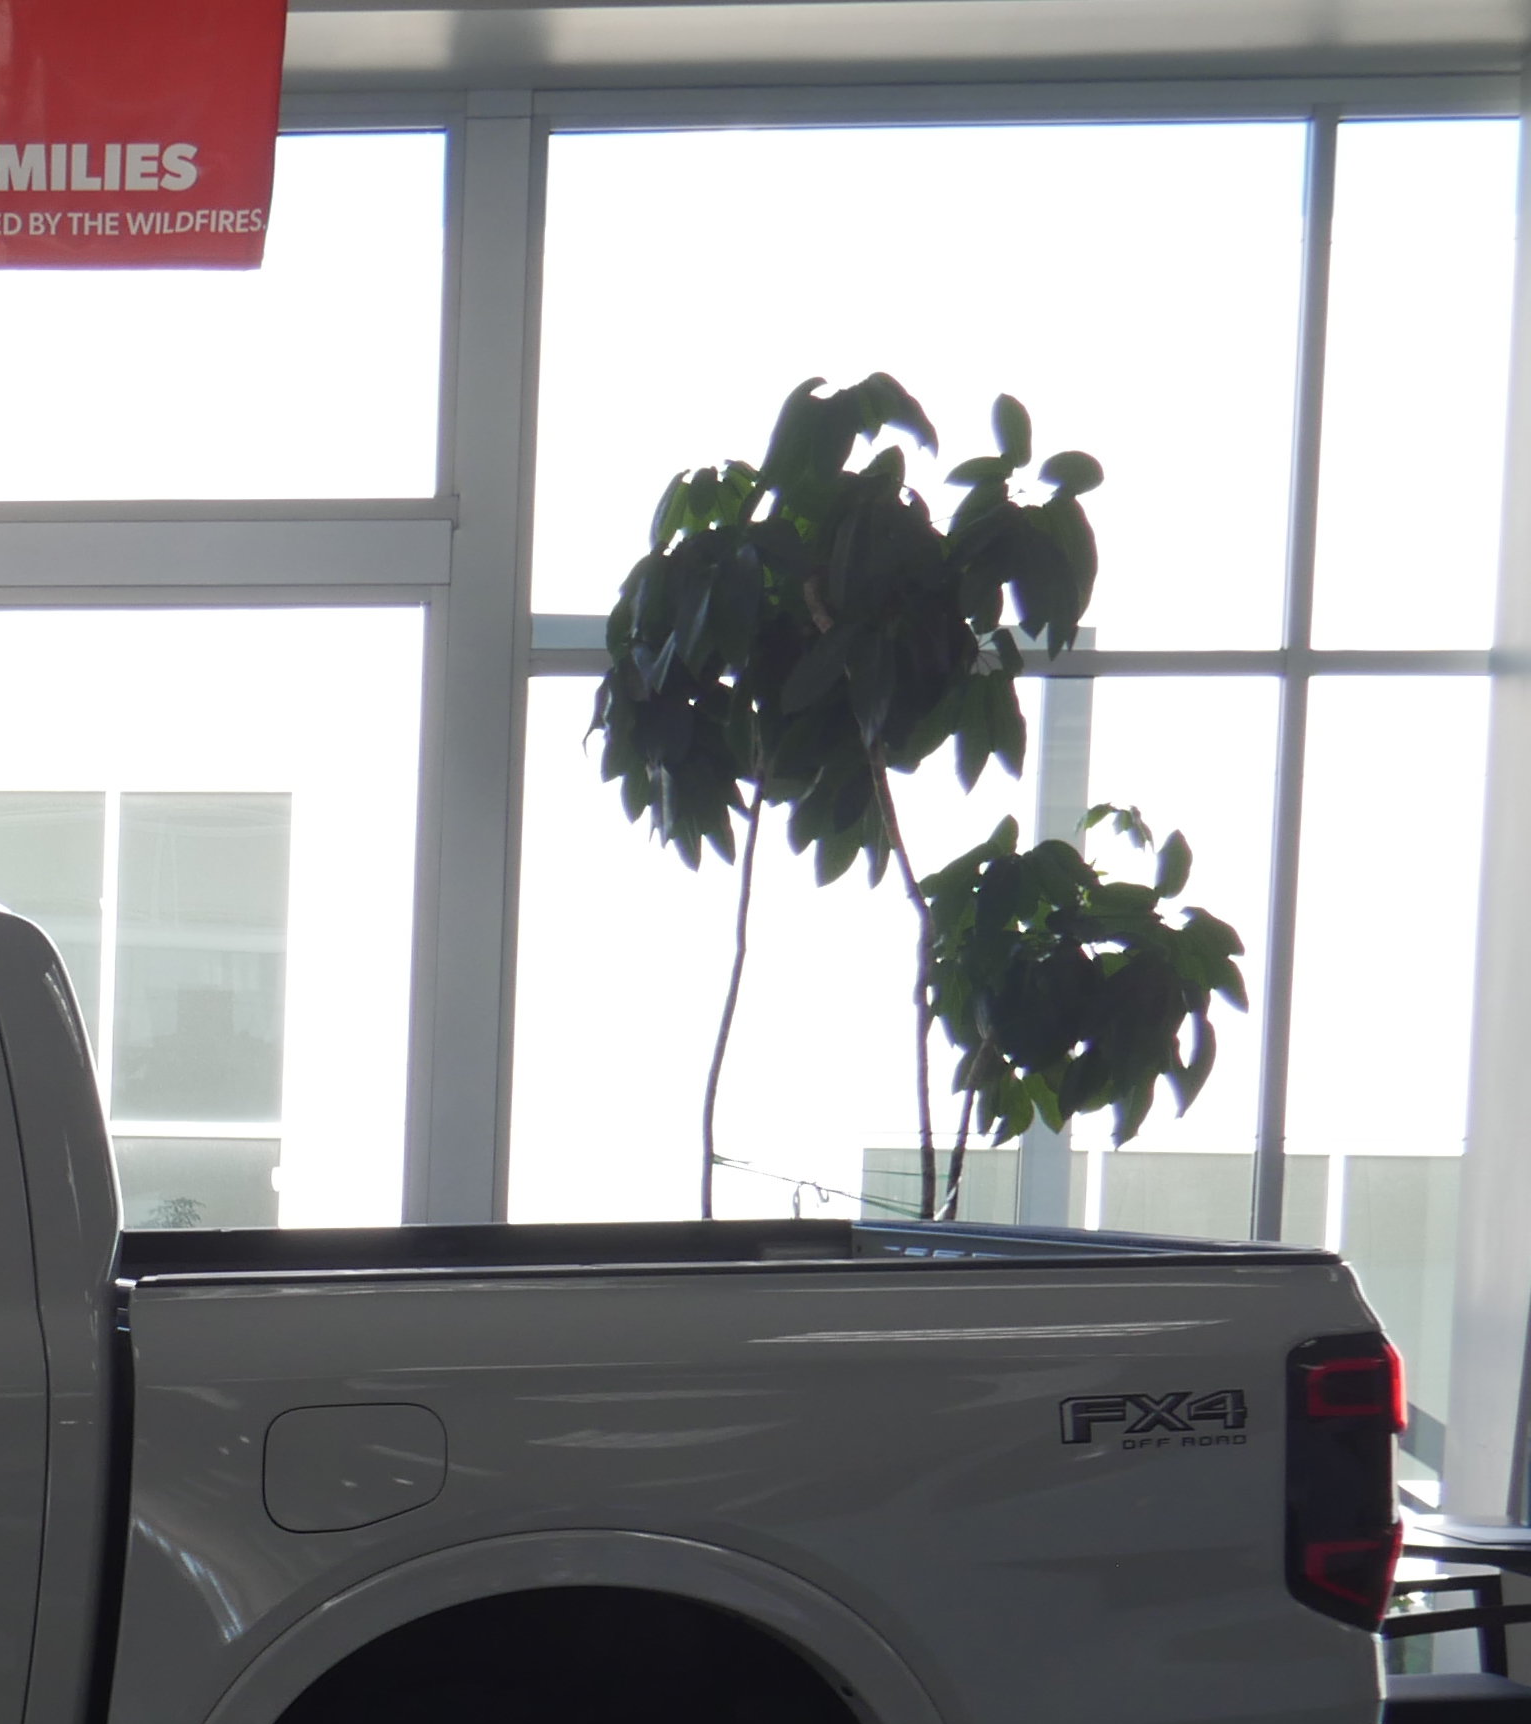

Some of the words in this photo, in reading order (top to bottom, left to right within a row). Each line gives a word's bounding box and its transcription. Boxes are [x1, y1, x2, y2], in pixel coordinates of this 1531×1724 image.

[28, 211, 63, 235] BY
[67, 211, 120, 235] THE
[126, 208, 267, 236] WILDFIRES.
[1059, 1389, 1248, 1445] FX4
[1122, 1436, 1171, 1450] OFF
[1181, 1434, 1247, 1448] ROAD
